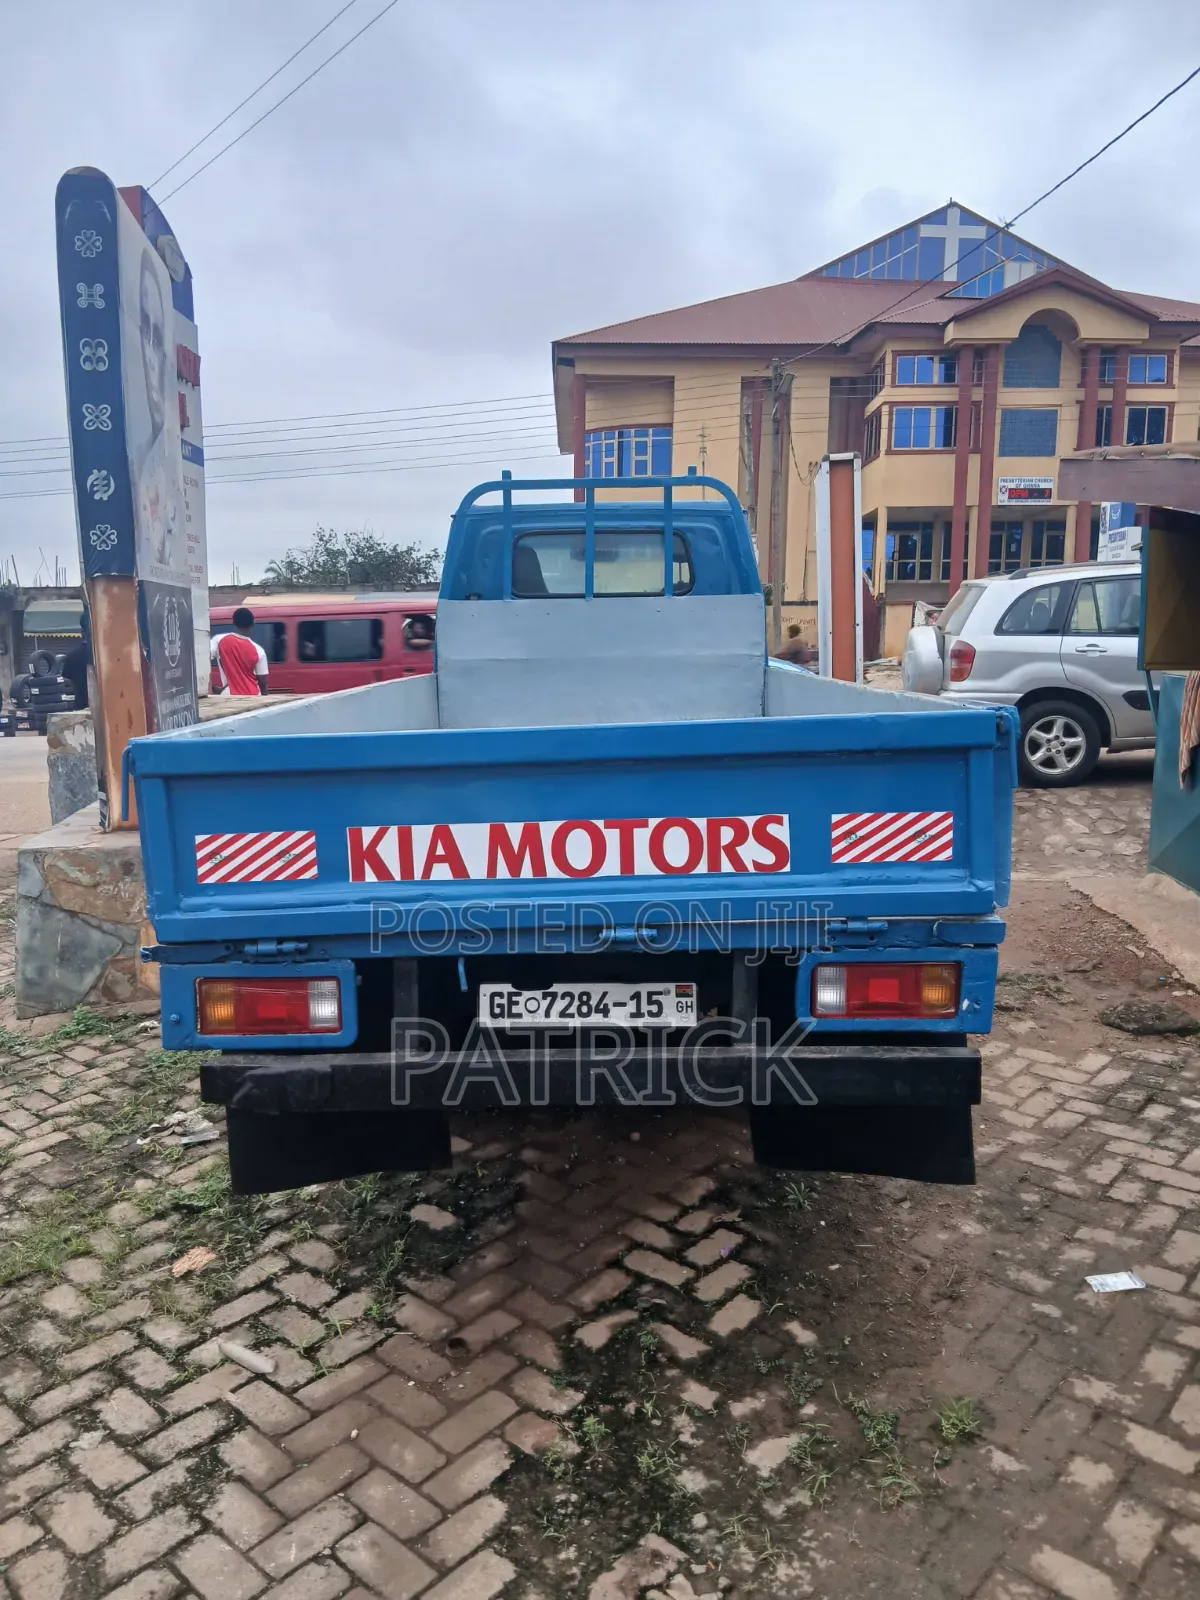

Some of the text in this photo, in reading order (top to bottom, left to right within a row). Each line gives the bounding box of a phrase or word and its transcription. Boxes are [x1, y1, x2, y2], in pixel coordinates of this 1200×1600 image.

[348, 814, 790, 883] KIA MOTORS
[675, 1000, 694, 1013] GH
